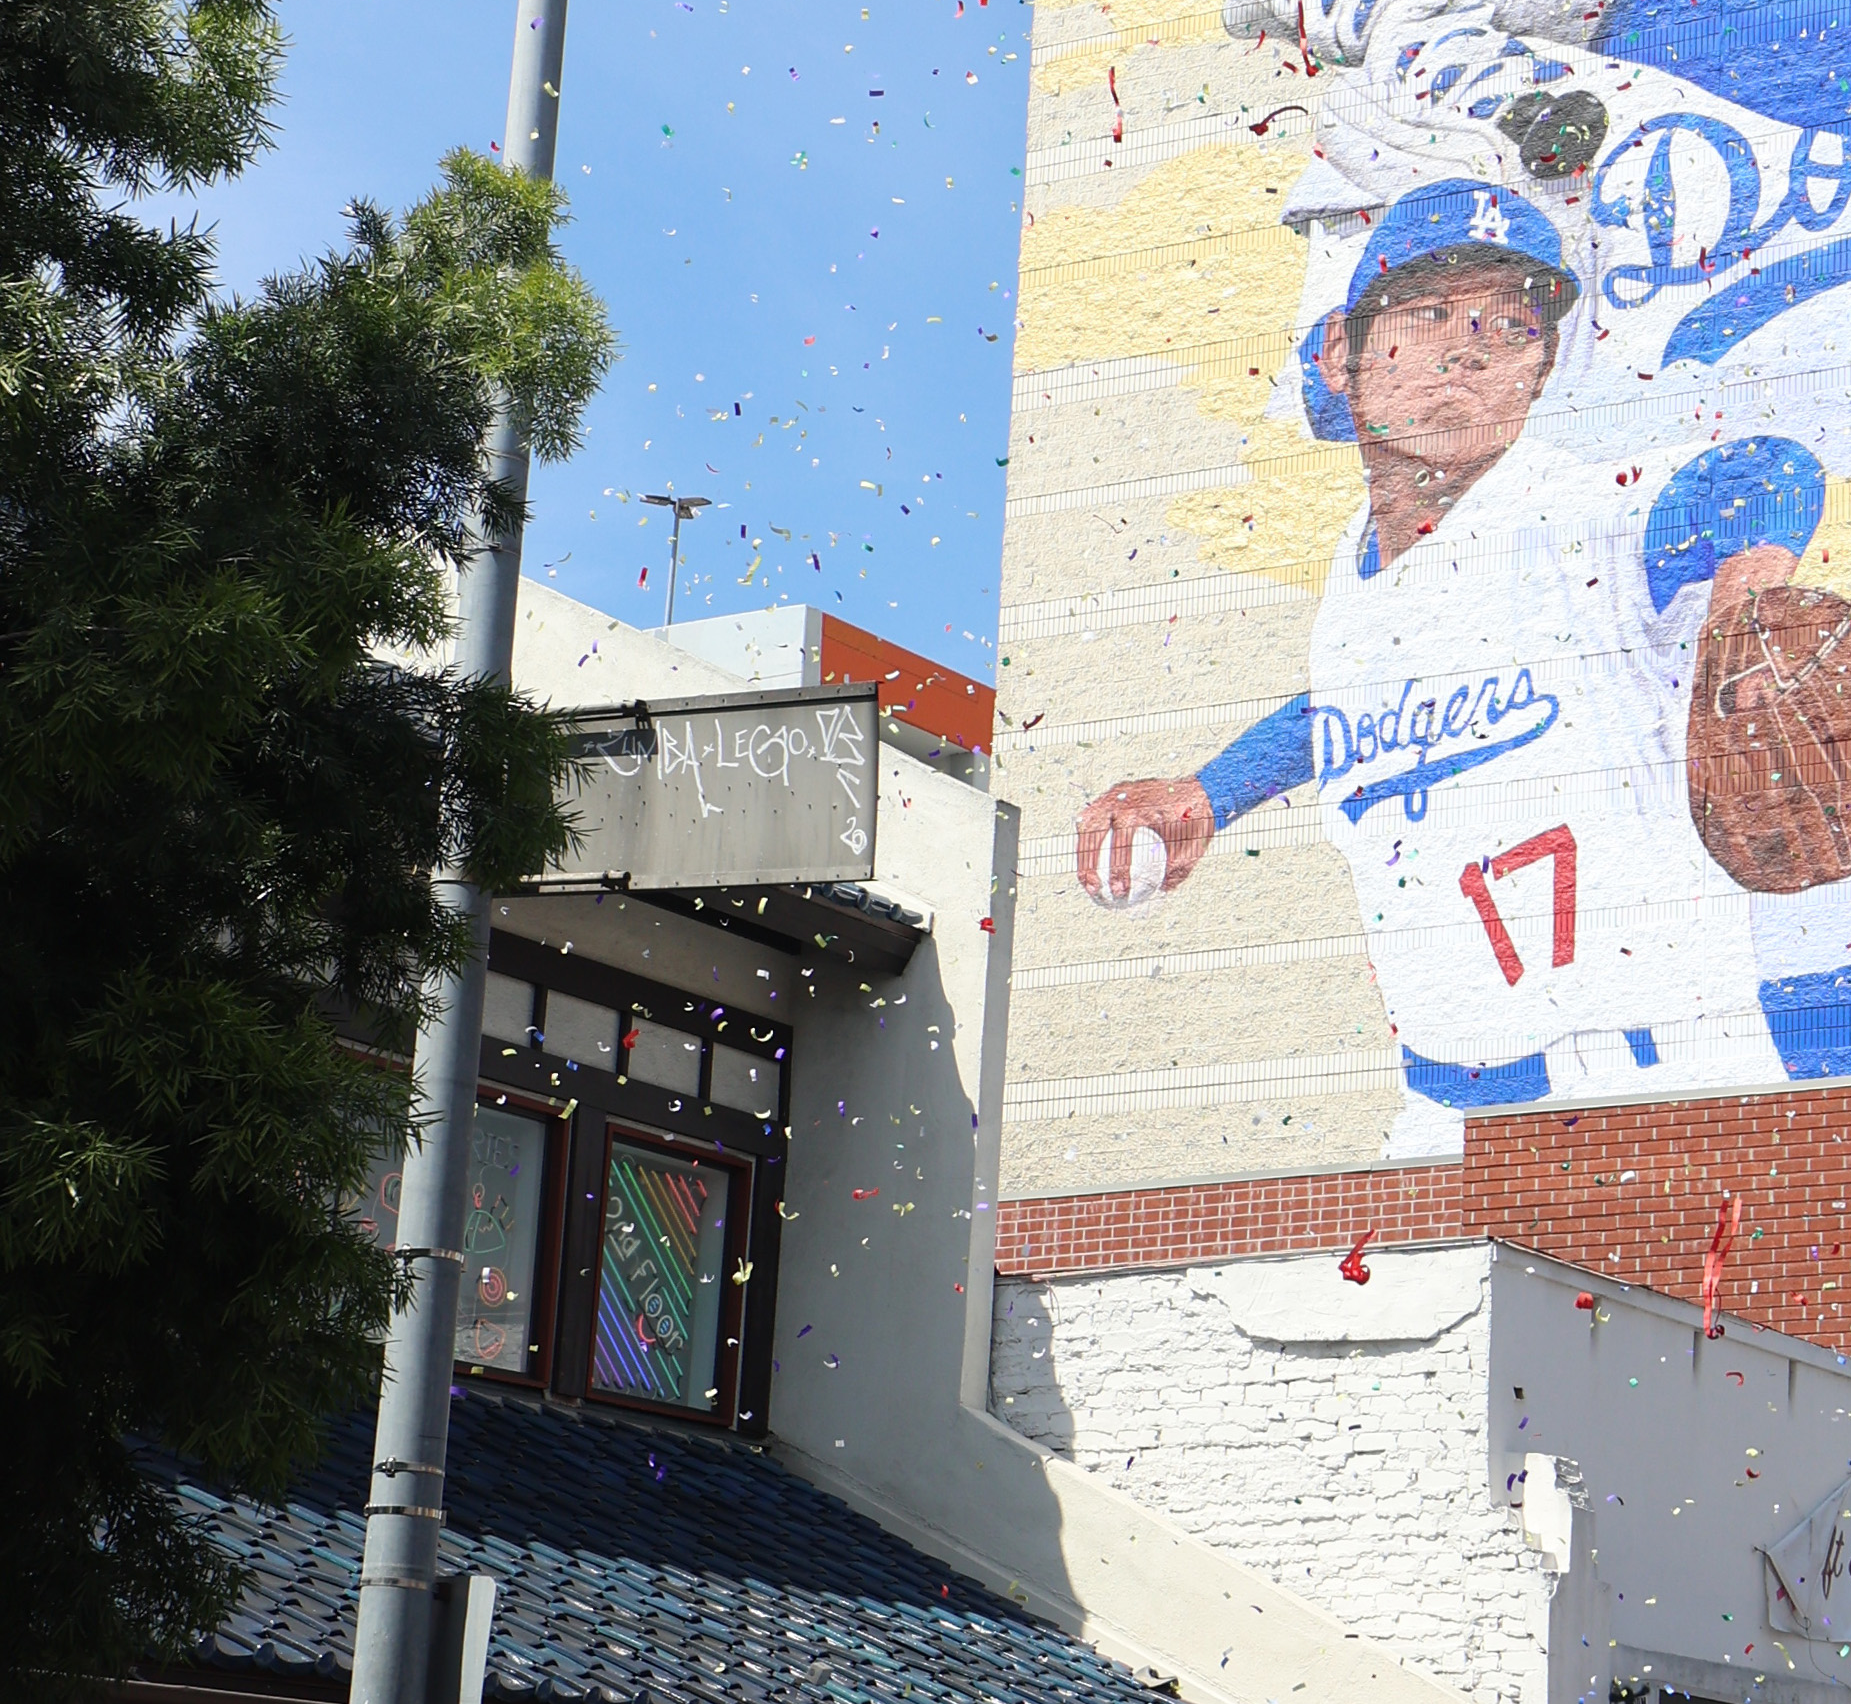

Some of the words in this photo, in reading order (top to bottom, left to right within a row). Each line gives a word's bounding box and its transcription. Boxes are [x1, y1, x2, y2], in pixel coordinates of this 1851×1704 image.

[1468, 190, 1511, 245] LA
[1312, 667, 1545, 823] Dodgers
[1458, 823, 1578, 988] 17
